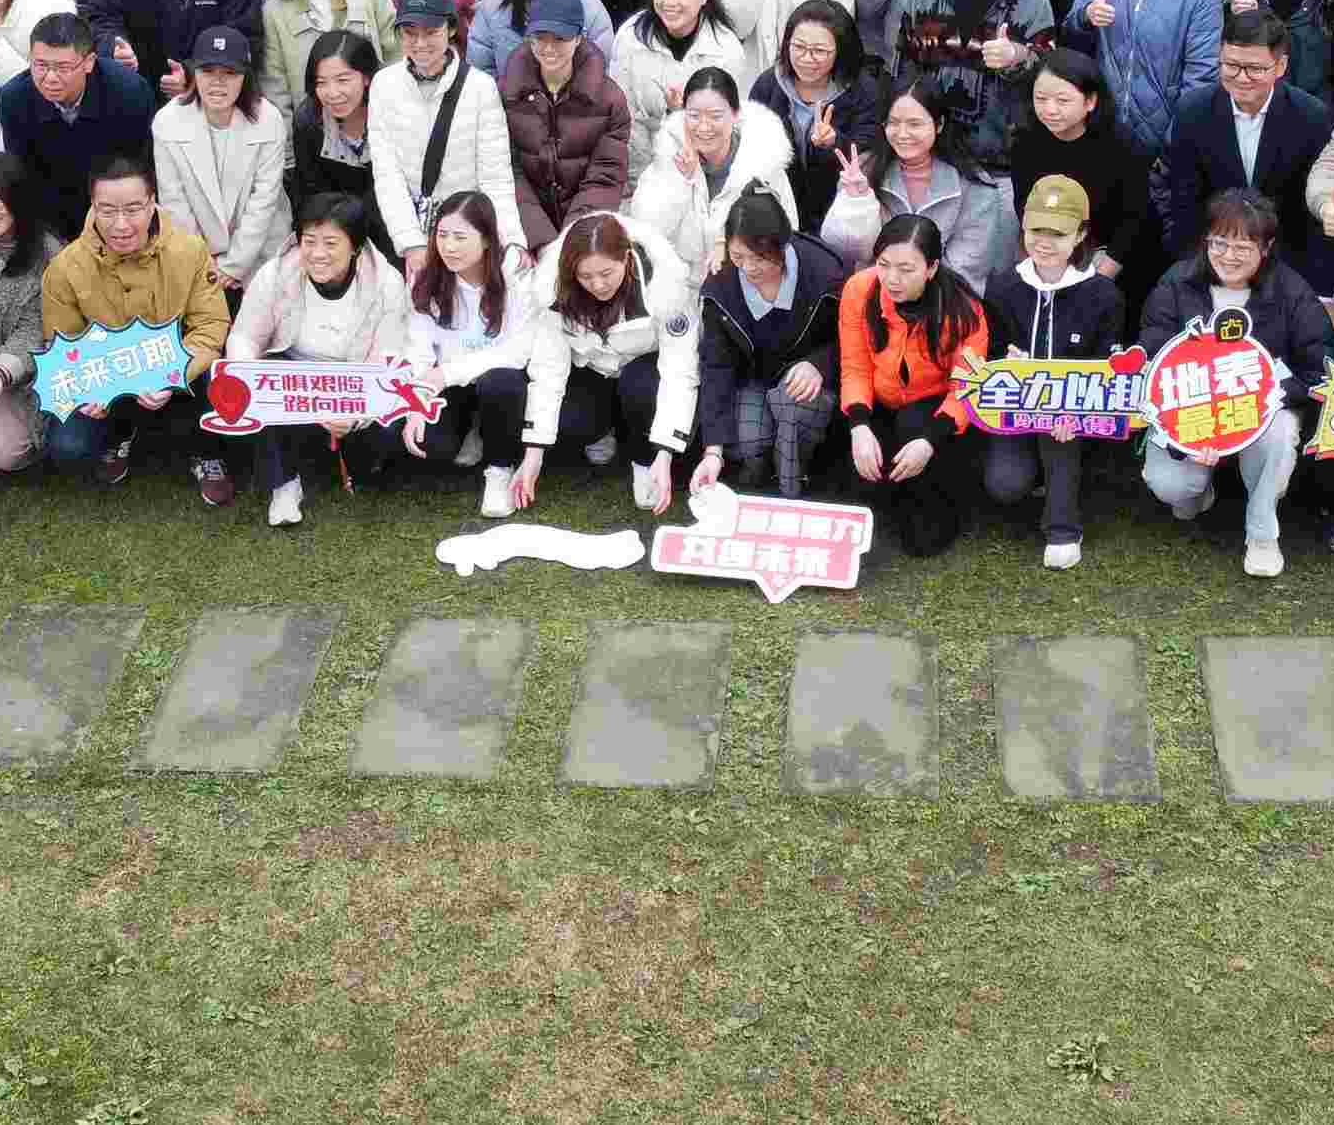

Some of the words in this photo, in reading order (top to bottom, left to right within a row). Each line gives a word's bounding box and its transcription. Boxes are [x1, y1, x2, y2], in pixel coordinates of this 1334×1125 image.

[51, 334, 179, 398] 未来可期
[254, 373, 364, 394] 无惧艰险
[1159, 351, 1264, 411] 地表
[257, 394, 366, 414] 一路向前
[1178, 395, 1261, 444] 最强
